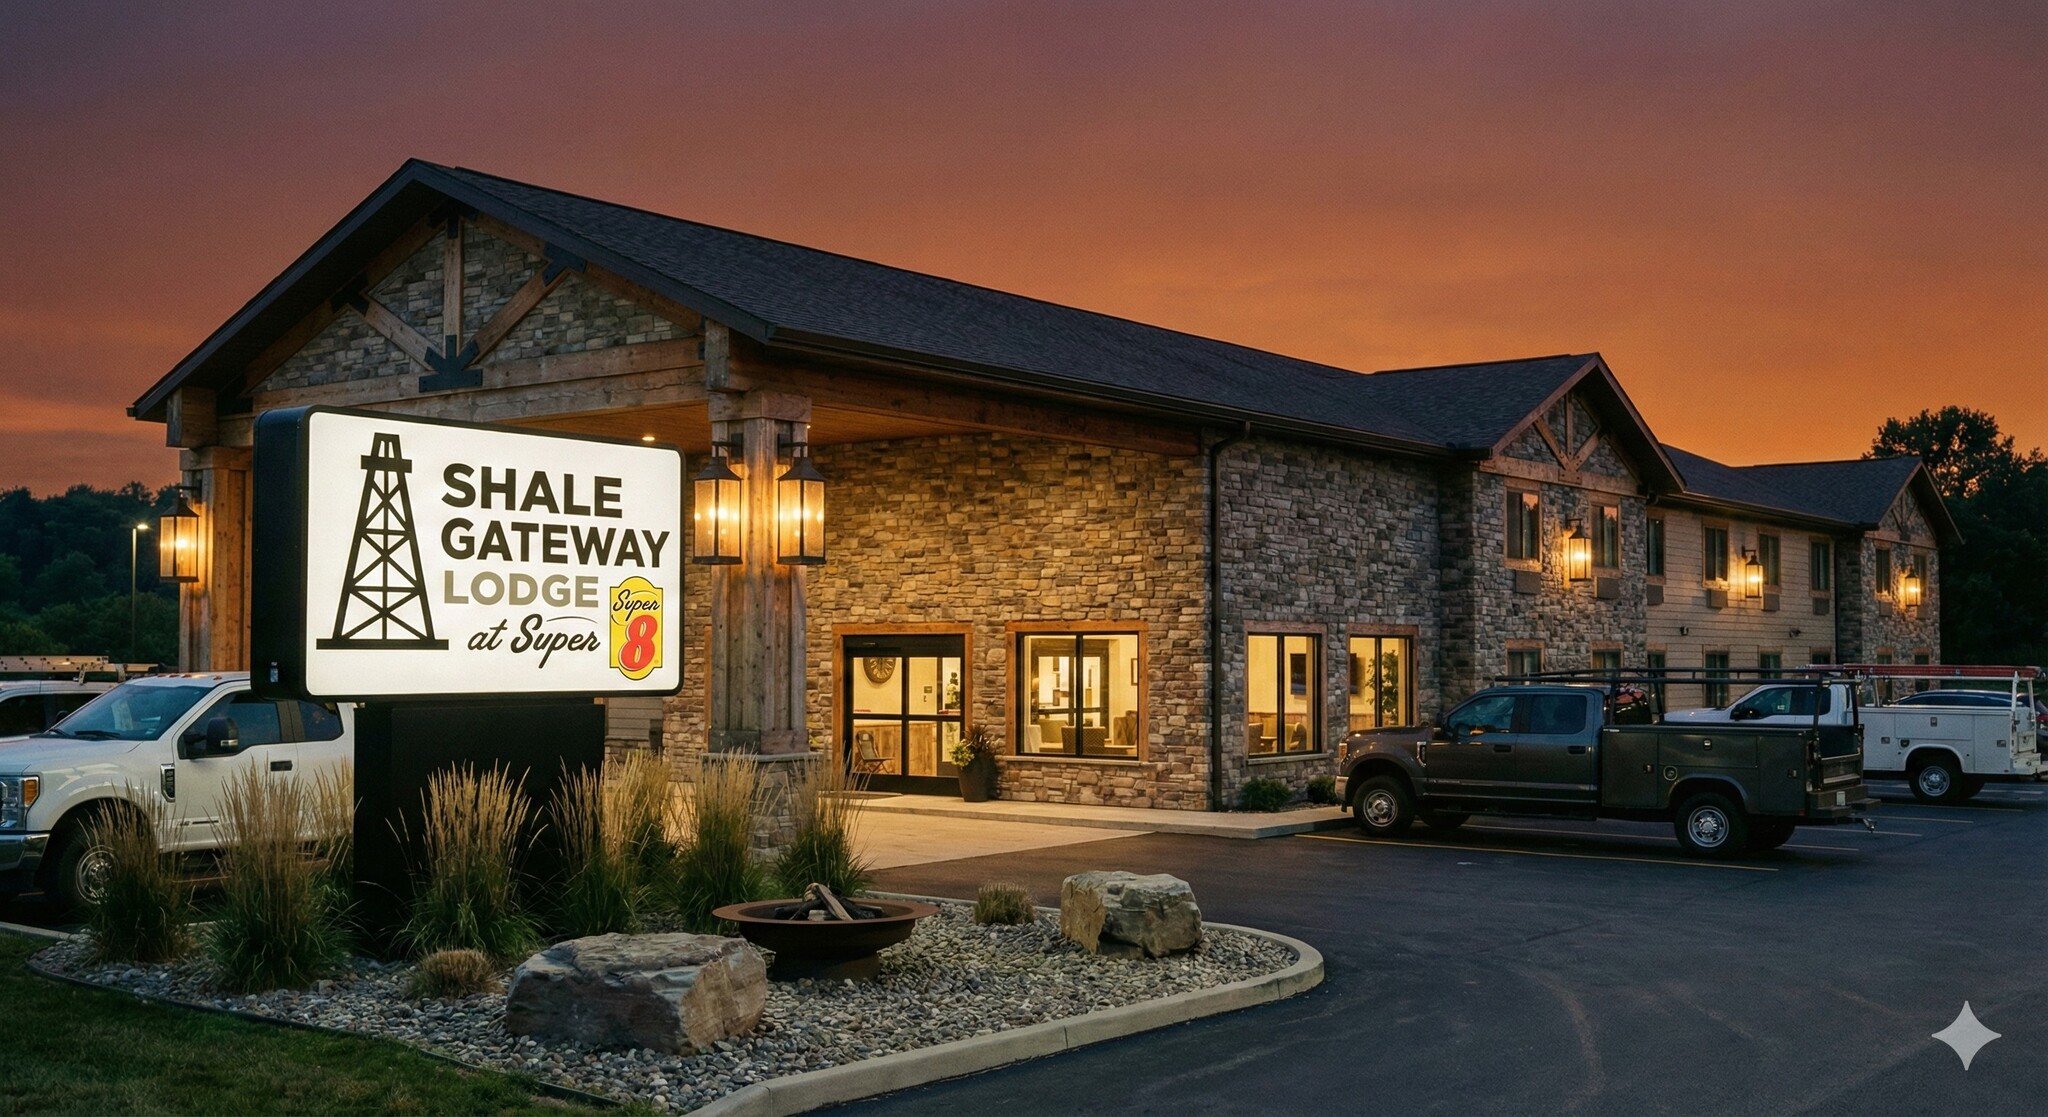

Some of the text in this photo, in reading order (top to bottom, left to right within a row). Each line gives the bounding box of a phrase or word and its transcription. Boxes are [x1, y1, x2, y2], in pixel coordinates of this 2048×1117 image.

[441, 463, 623, 518] SHALE
[441, 518, 670, 567] GATEWAY
[444, 570, 599, 608] LODGE
[612, 589, 660, 621] Super
[467, 613, 601, 669] at Super
[618, 614, 658, 671] 8
